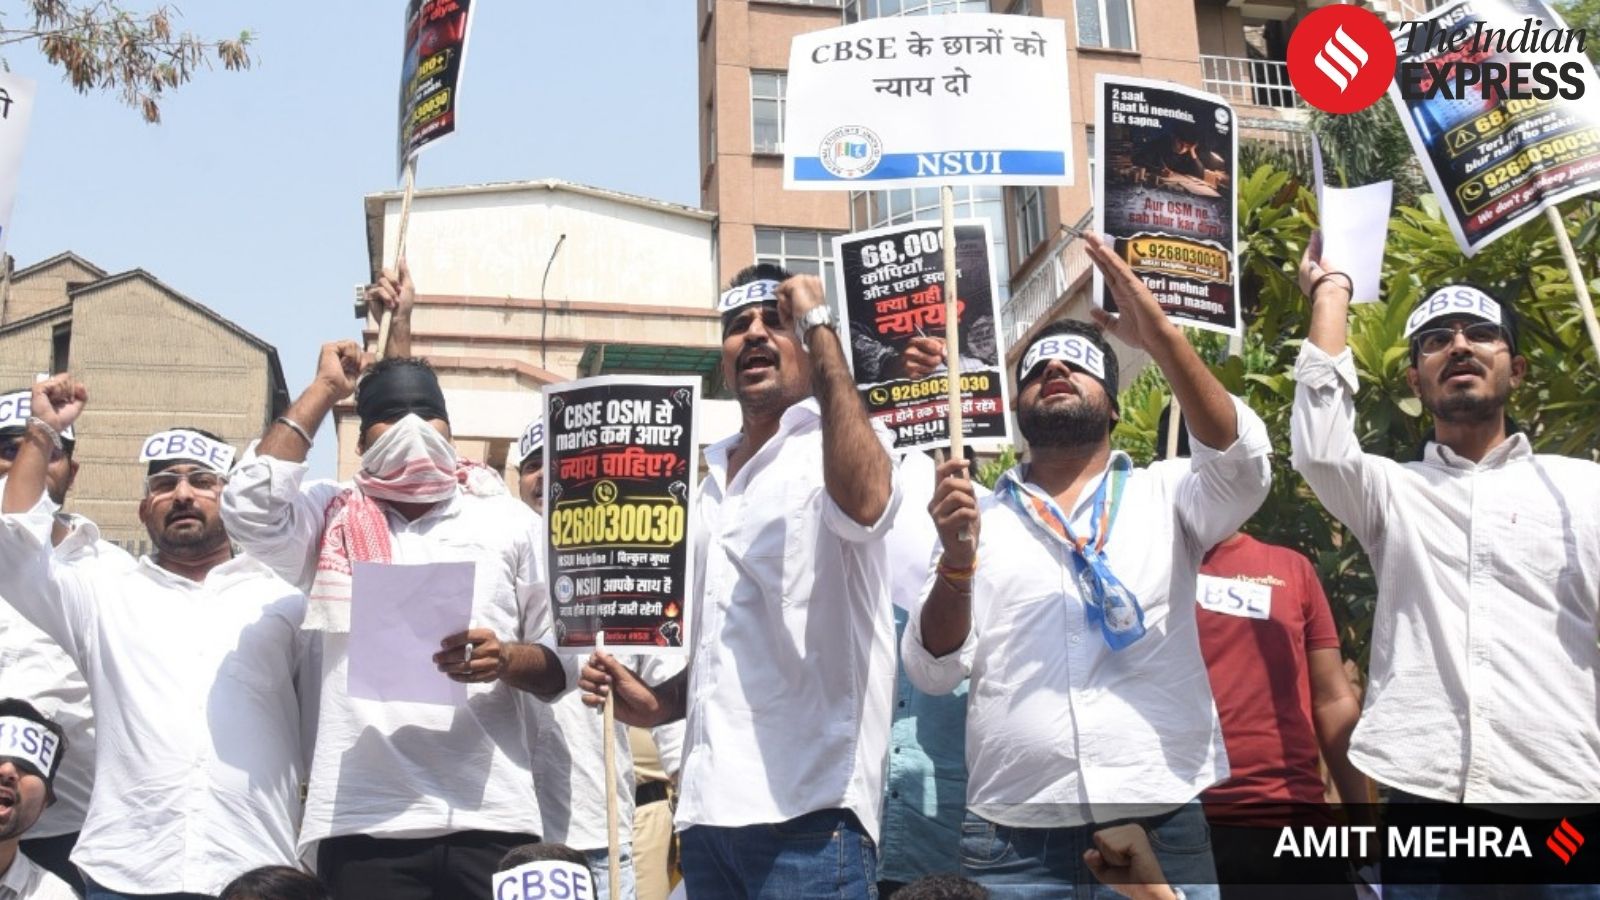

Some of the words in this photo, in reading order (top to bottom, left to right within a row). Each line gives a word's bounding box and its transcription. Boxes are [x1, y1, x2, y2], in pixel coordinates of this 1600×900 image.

[811, 36, 897, 64] CBSE
[905, 31, 933, 57] के
[940, 29, 1003, 55] छात्रों
[1011, 31, 1047, 58] को
[873, 77, 934, 97] न्याय
[942, 67, 971, 96] दो
[1112, 88, 1119, 99] 2
[1121, 91, 1146, 102] saal.
[1112, 101, 1137, 112] Raat
[1139, 103, 1149, 114] ki
[1112, 113, 1125, 123] Ek
[1128, 115, 1162, 128] sapna.
[1465, 154, 1490, 173] blur
[1522, 129, 1540, 140] ho
[1477, 135, 1505, 154] Teri
[917, 151, 1002, 176] NSUI
[1129, 211, 1149, 224] sab
[1177, 217, 1194, 230] kar
[1144, 197, 1164, 211] Aur
[1167, 201, 1192, 217] OSM
[725, 283, 779, 307] CB
[863, 284, 891, 301] और
[892, 277, 920, 293] एक
[875, 296, 907, 313] क्या
[911, 284, 941, 304] यही
[1142, 276, 1166, 290] Teri
[1168, 281, 1209, 297] mehnat
[1410, 289, 1497, 329] CBSE
[1024, 339, 1100, 374] CBSE
[891, 376, 990, 401] 926803030
[564, 401, 603, 430] CBSE
[606, 399, 652, 425] OSM
[655, 398, 674, 424] से
[521, 423, 543, 457] CB
[556, 427, 597, 451] marks
[600, 425, 632, 445] कम
[635, 424, 683, 446] आए?
[899, 420, 945, 438] NSUI
[145, 434, 225, 469] CBSE
[560, 454, 598, 480] न्याय
[602, 447, 677, 477] चाहिए?
[551, 504, 684, 546] 9268030030
[576, 577, 601, 597] NSUI
[603, 575, 635, 593] आपके
[636, 579, 661, 593] साथ
[1204, 582, 1264, 614] BSE
[0, 722, 54, 768] BSE
[497, 868, 588, 900] CBSE
